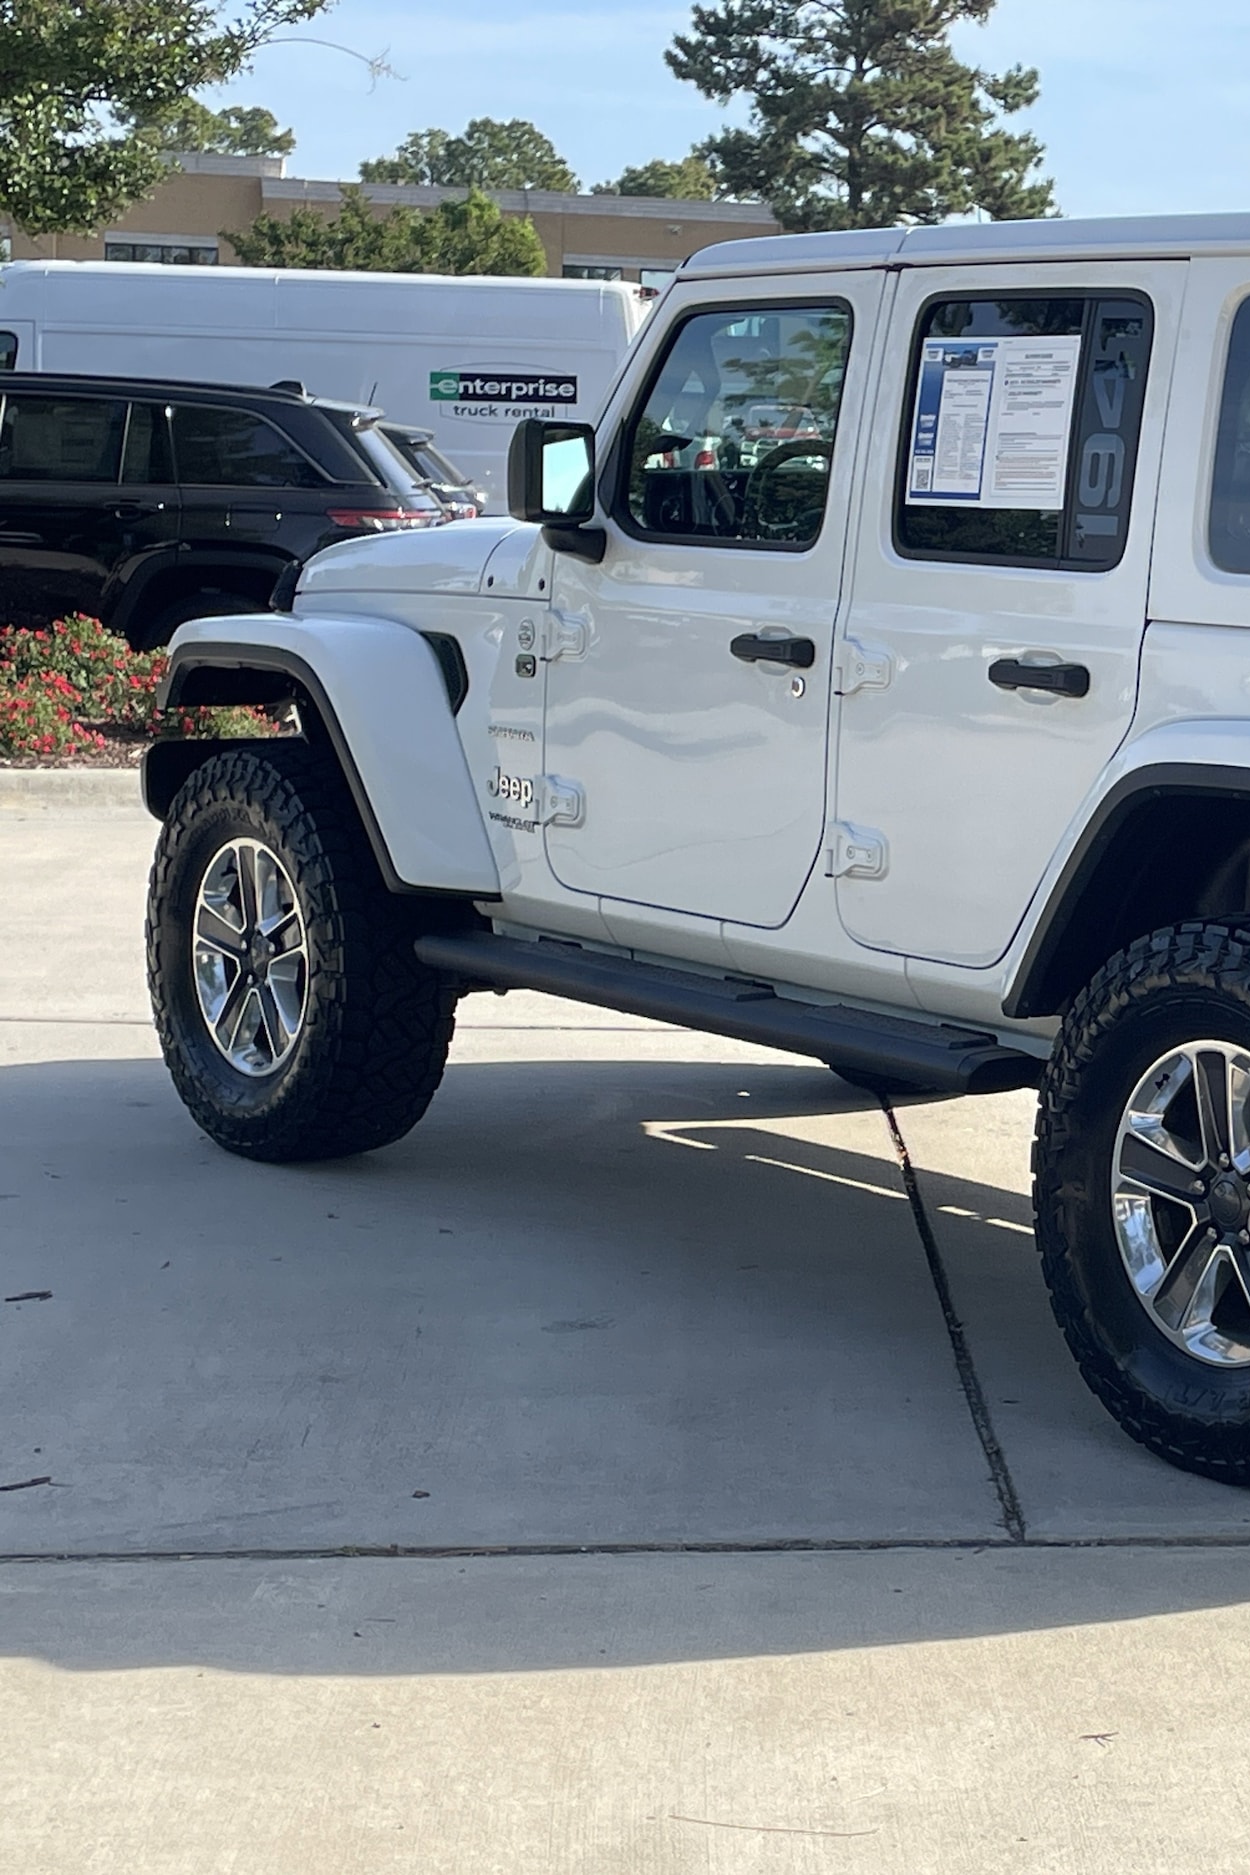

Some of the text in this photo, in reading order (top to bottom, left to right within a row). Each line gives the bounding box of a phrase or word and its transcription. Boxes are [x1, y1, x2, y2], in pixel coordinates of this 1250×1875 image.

[437, 379, 575, 399] enterprise
[453, 404, 556, 418] truck rental
[487, 765, 533, 809] Jeep
